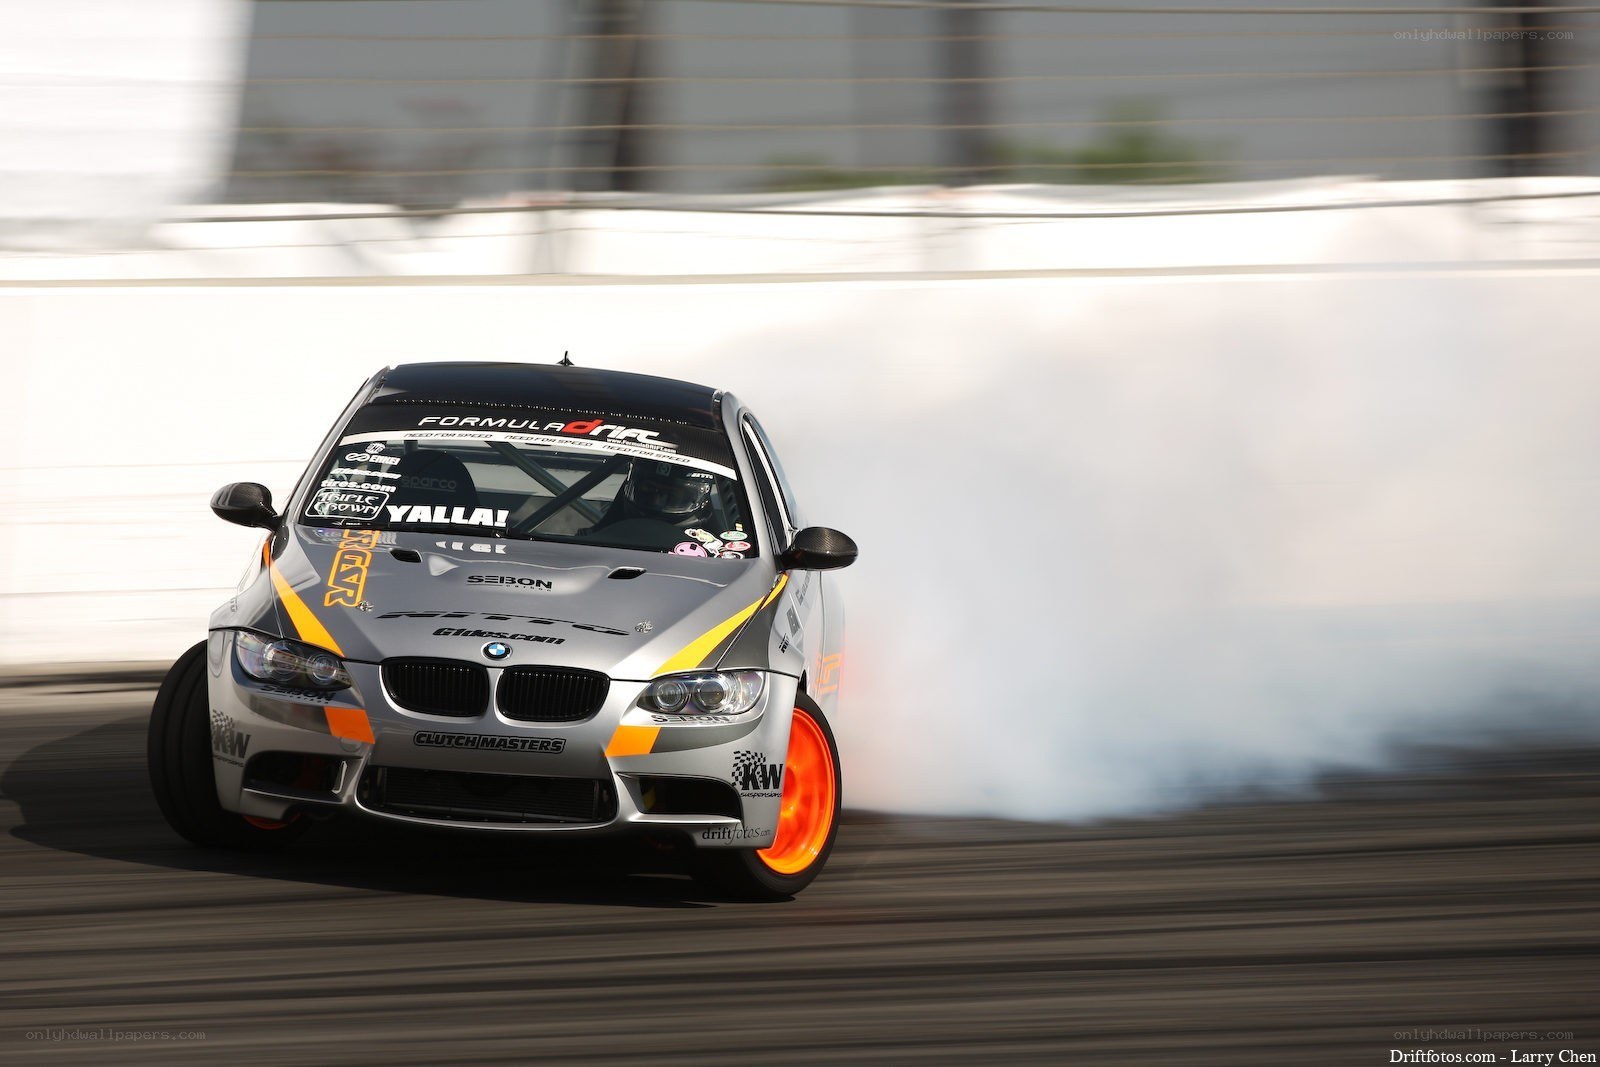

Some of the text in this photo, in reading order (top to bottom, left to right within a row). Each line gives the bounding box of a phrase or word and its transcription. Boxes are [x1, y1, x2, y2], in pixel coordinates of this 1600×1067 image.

[418, 416, 565, 432] FORMULA
[557, 439, 593, 447] SPEED
[602, 444, 631, 452] NEED
[655, 453, 690, 463] SPEED
[320, 479, 396, 493] tires.com
[401, 476, 457, 490] sparco
[386, 505, 509, 527] YALLA!
[415, 732, 563, 751] CLUTCH MASTERS
[741, 763, 783, 790] KW
